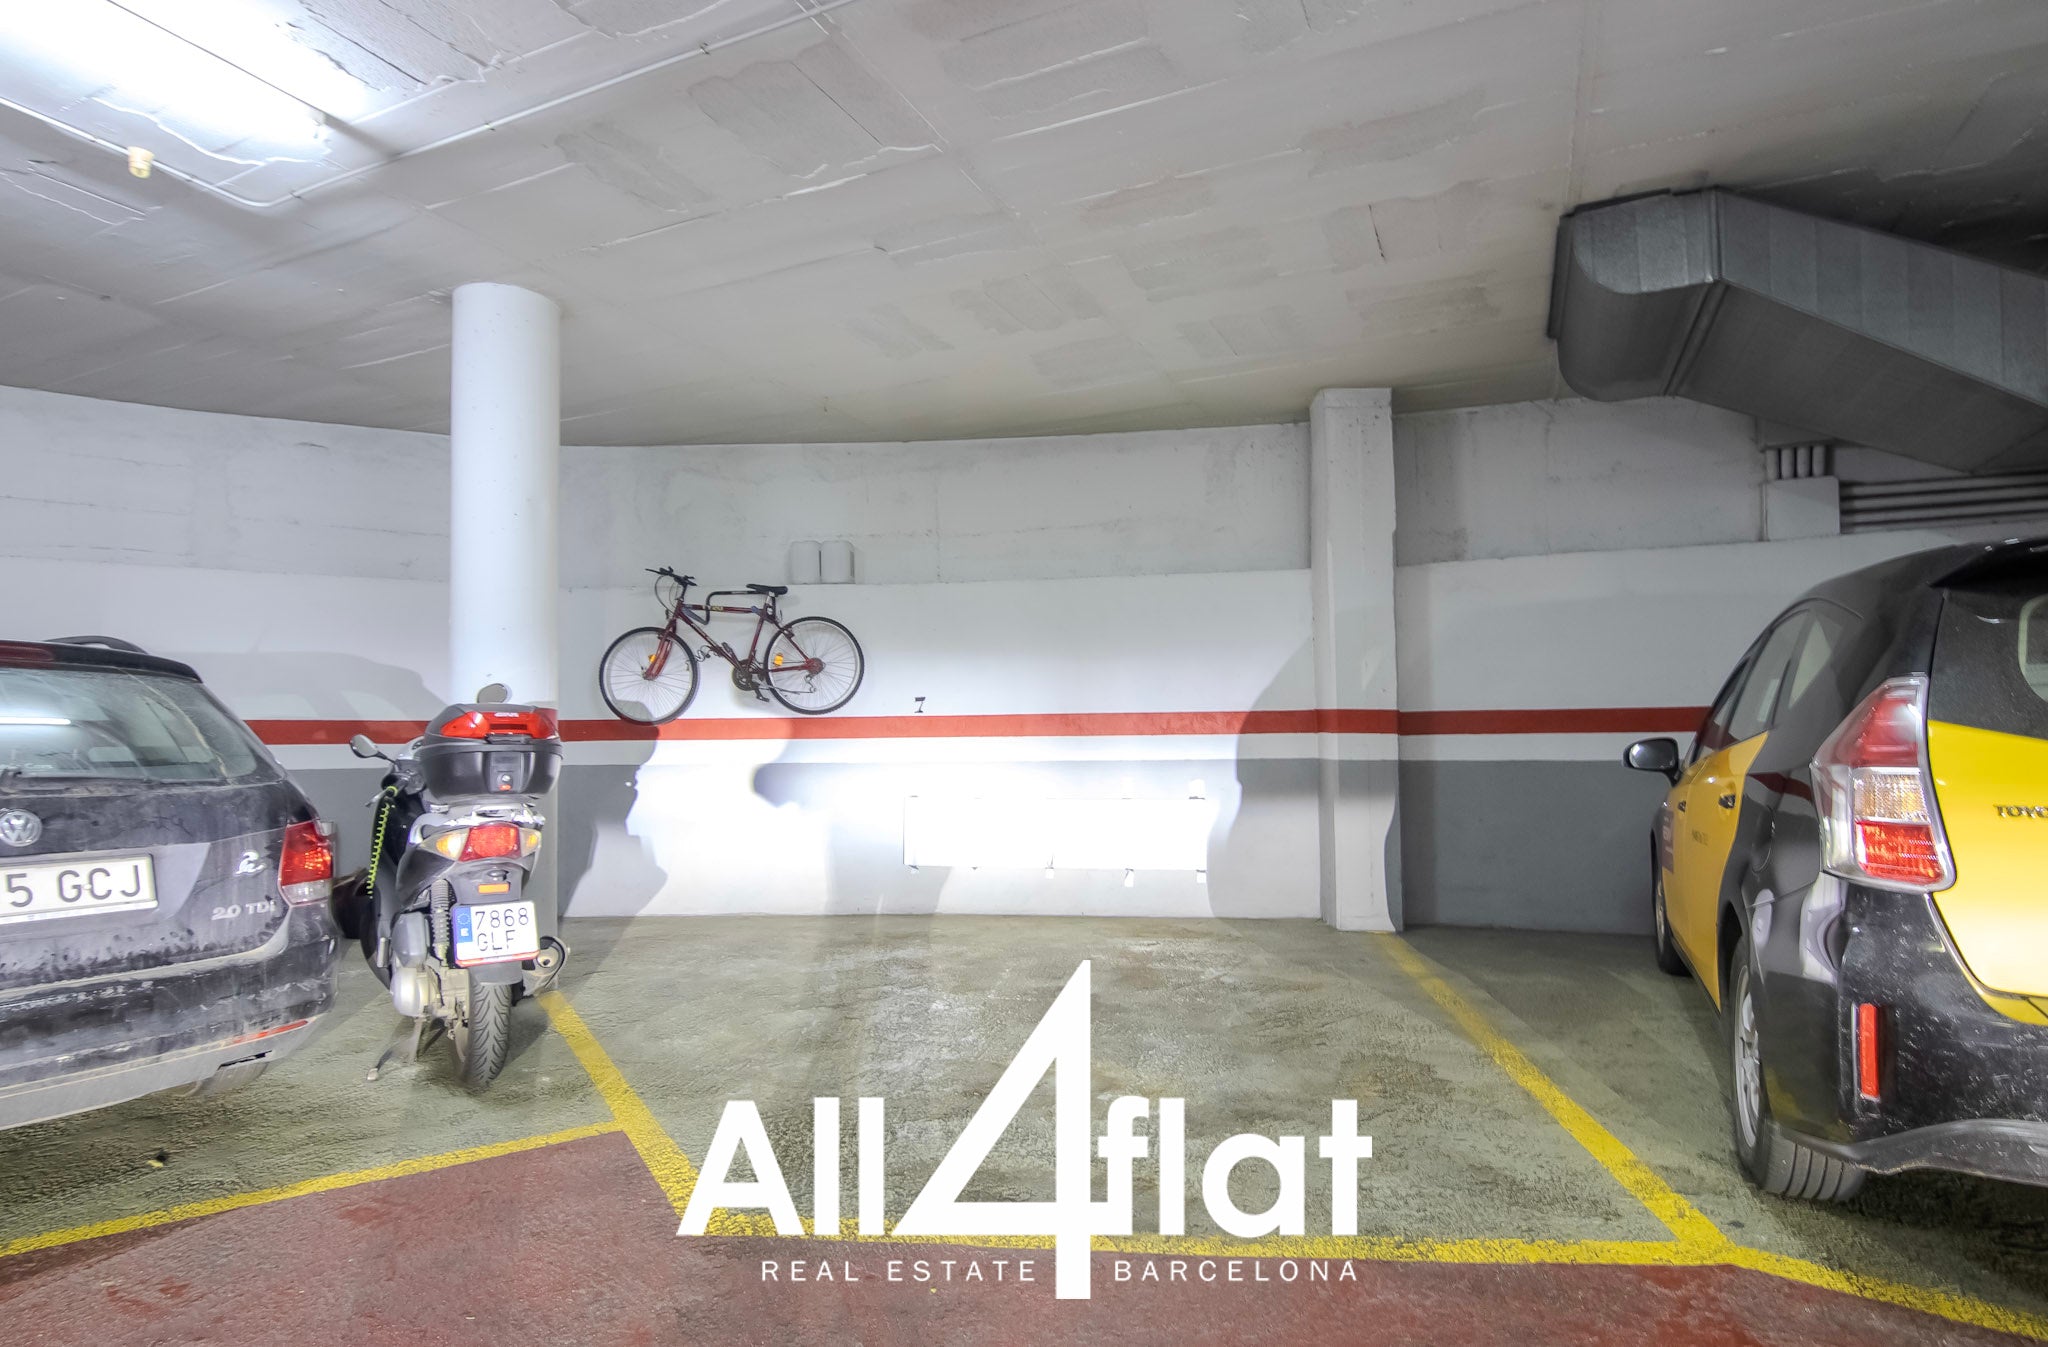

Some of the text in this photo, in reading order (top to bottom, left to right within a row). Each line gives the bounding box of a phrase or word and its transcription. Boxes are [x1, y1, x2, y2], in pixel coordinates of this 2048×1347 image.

[5, 864, 141, 908] 5 GCJ
[475, 907, 529, 930] 7868
[477, 929, 516, 952] GLF
